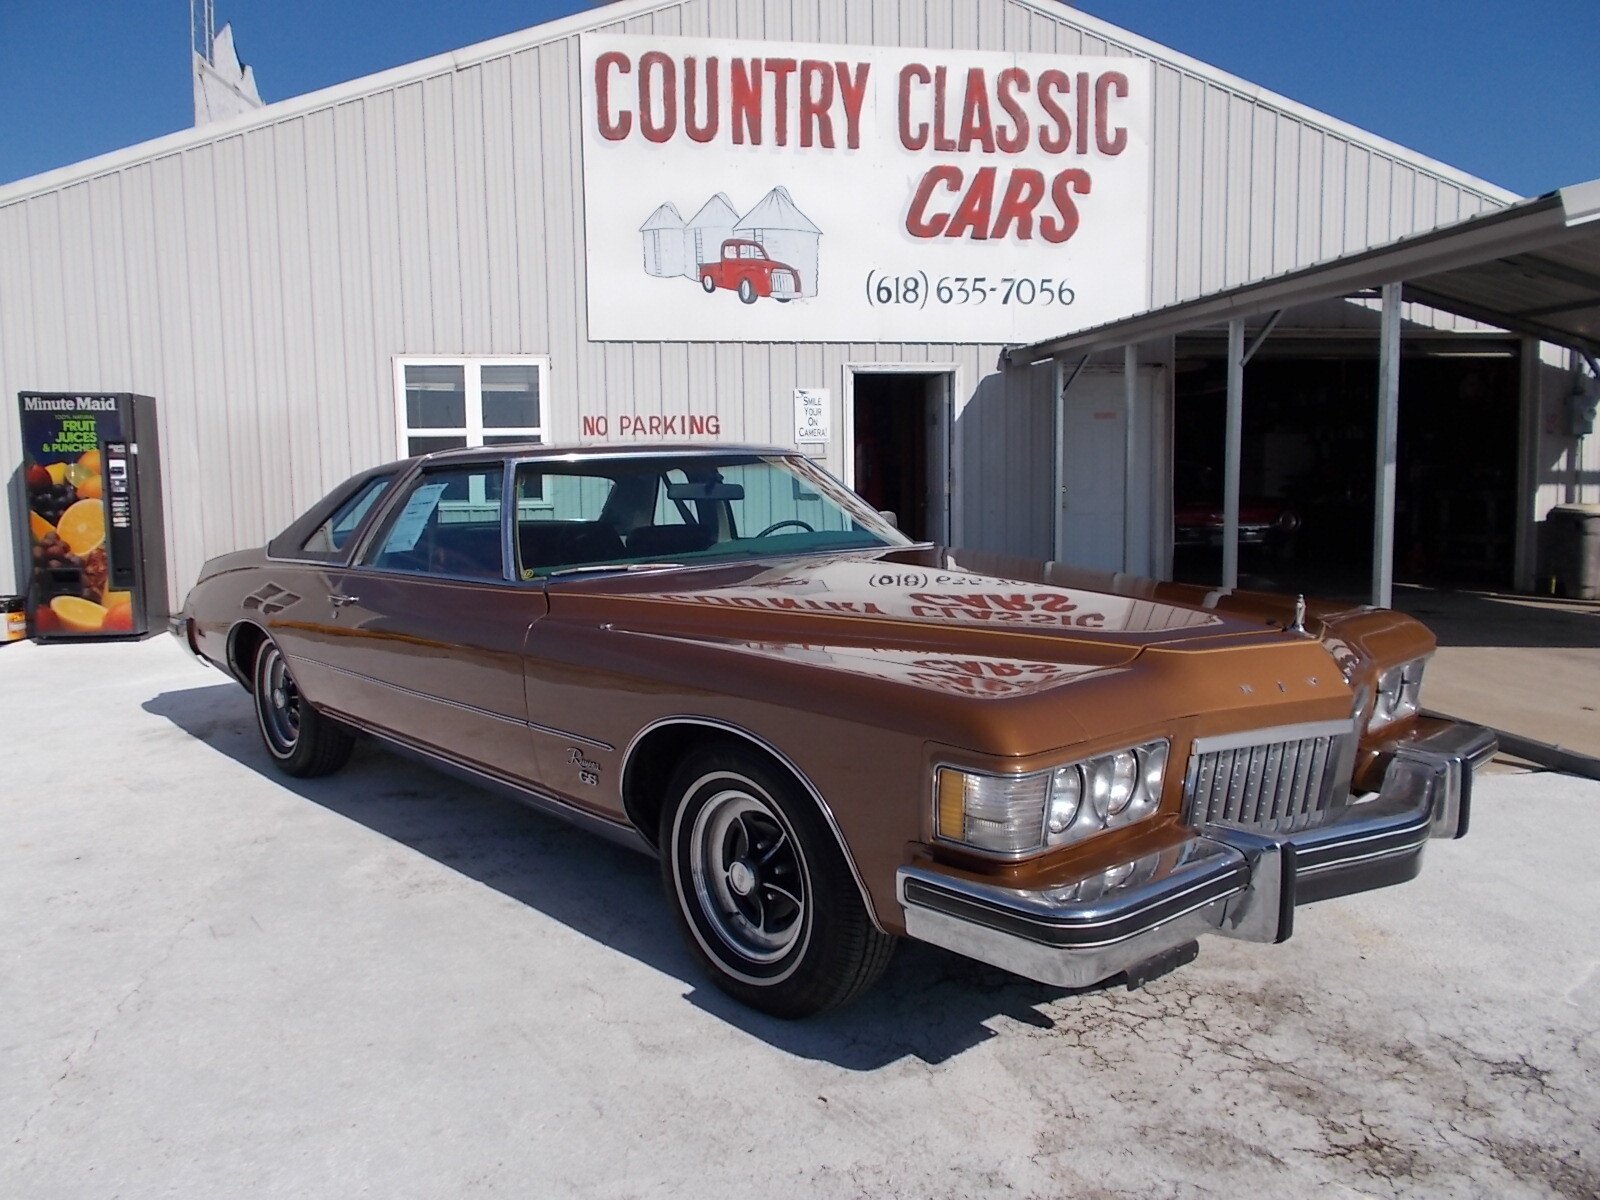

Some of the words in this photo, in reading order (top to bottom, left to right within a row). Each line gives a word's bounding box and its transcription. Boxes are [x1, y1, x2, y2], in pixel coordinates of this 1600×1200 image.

[594, 51, 871, 149] COUNTRY
[898, 63, 1130, 156] CLASSIC
[905, 164, 1092, 243] CARS
[866, 270, 929, 307] (618)
[936, 276, 1076, 306] 635-7056
[24, 397, 75, 411] Minute
[76, 397, 116, 411] Maid
[63, 421, 96, 431] FRUIT
[583, 416, 608, 436] NO
[620, 415, 721, 435] PARKING
[56, 432, 97, 442] JUICES
[43, 443, 50, 452] &
[53, 443, 97, 452] PUNCHES
